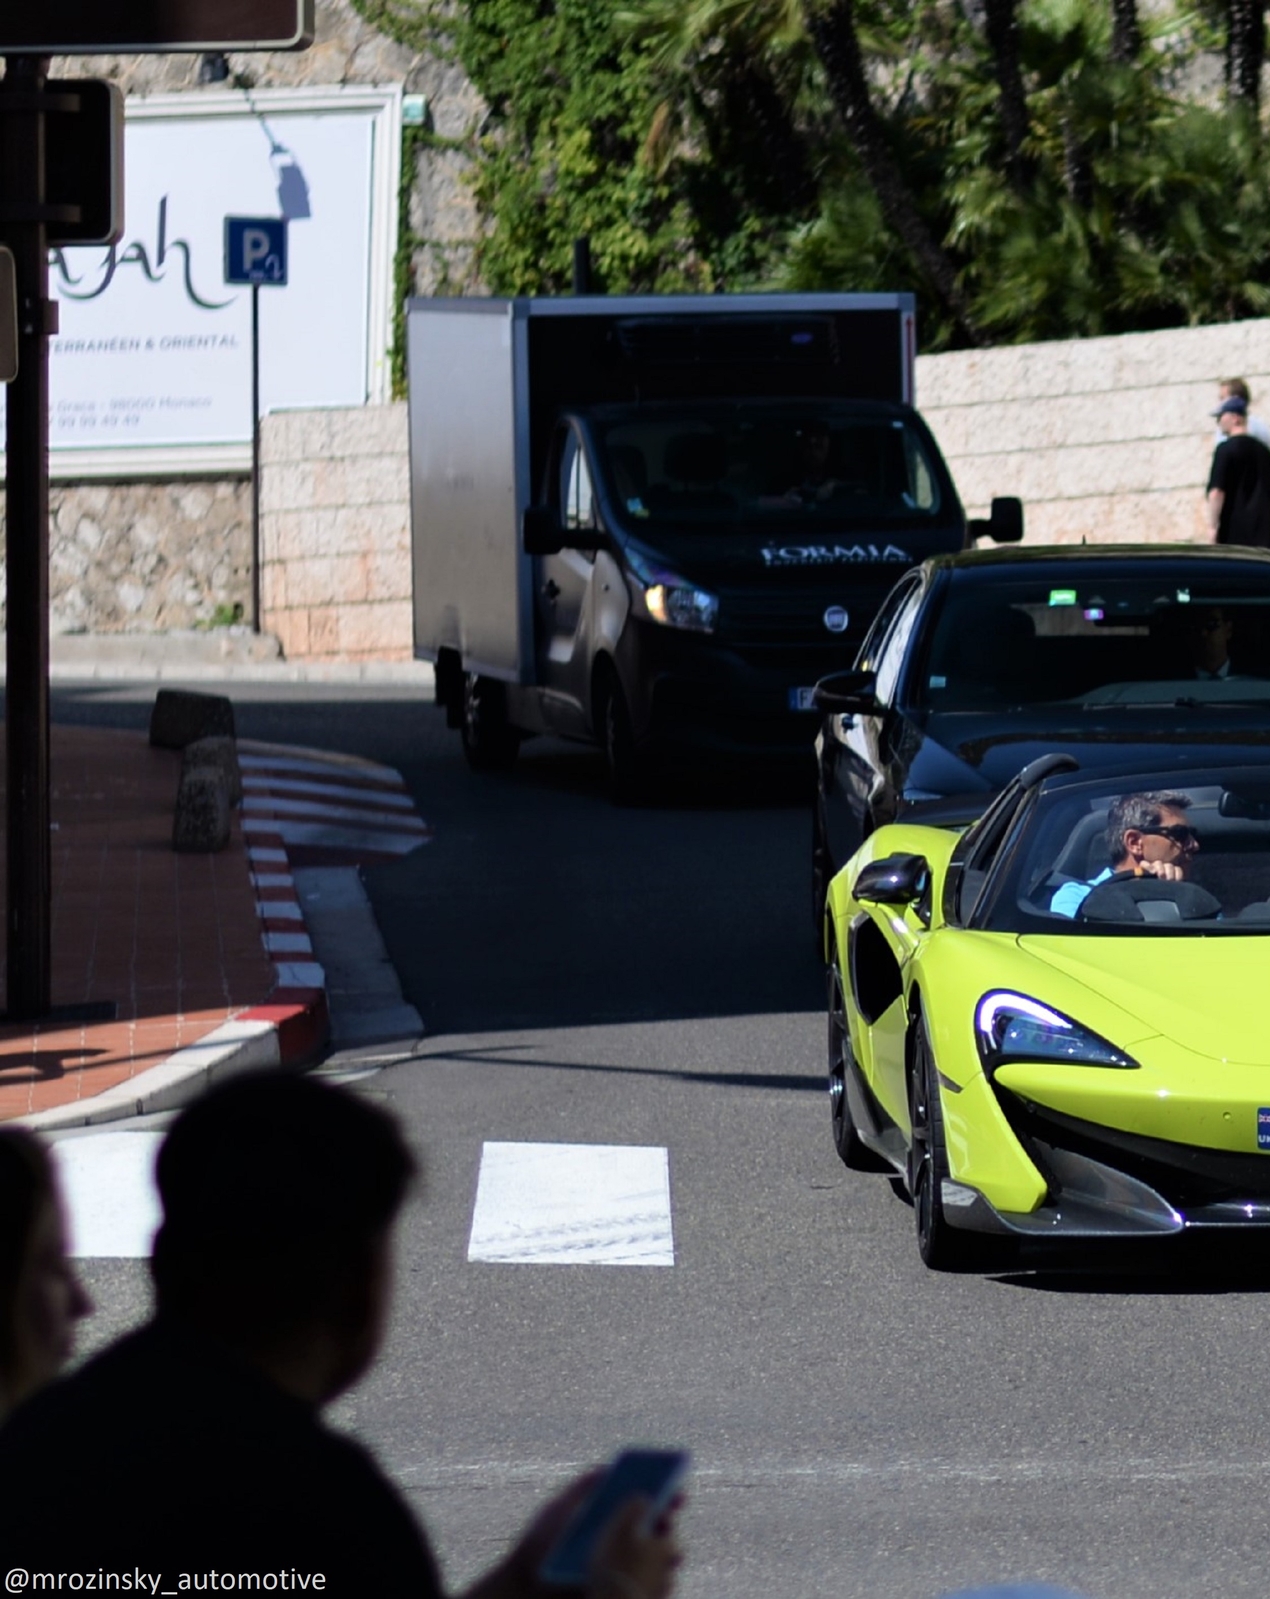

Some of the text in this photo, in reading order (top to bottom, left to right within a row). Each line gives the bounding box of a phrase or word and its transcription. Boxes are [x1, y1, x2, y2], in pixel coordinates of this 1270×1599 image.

[243, 228, 270, 272] P
[160, 334, 238, 352] ORIENTAL
[760, 542, 908, 562] FORMIA
